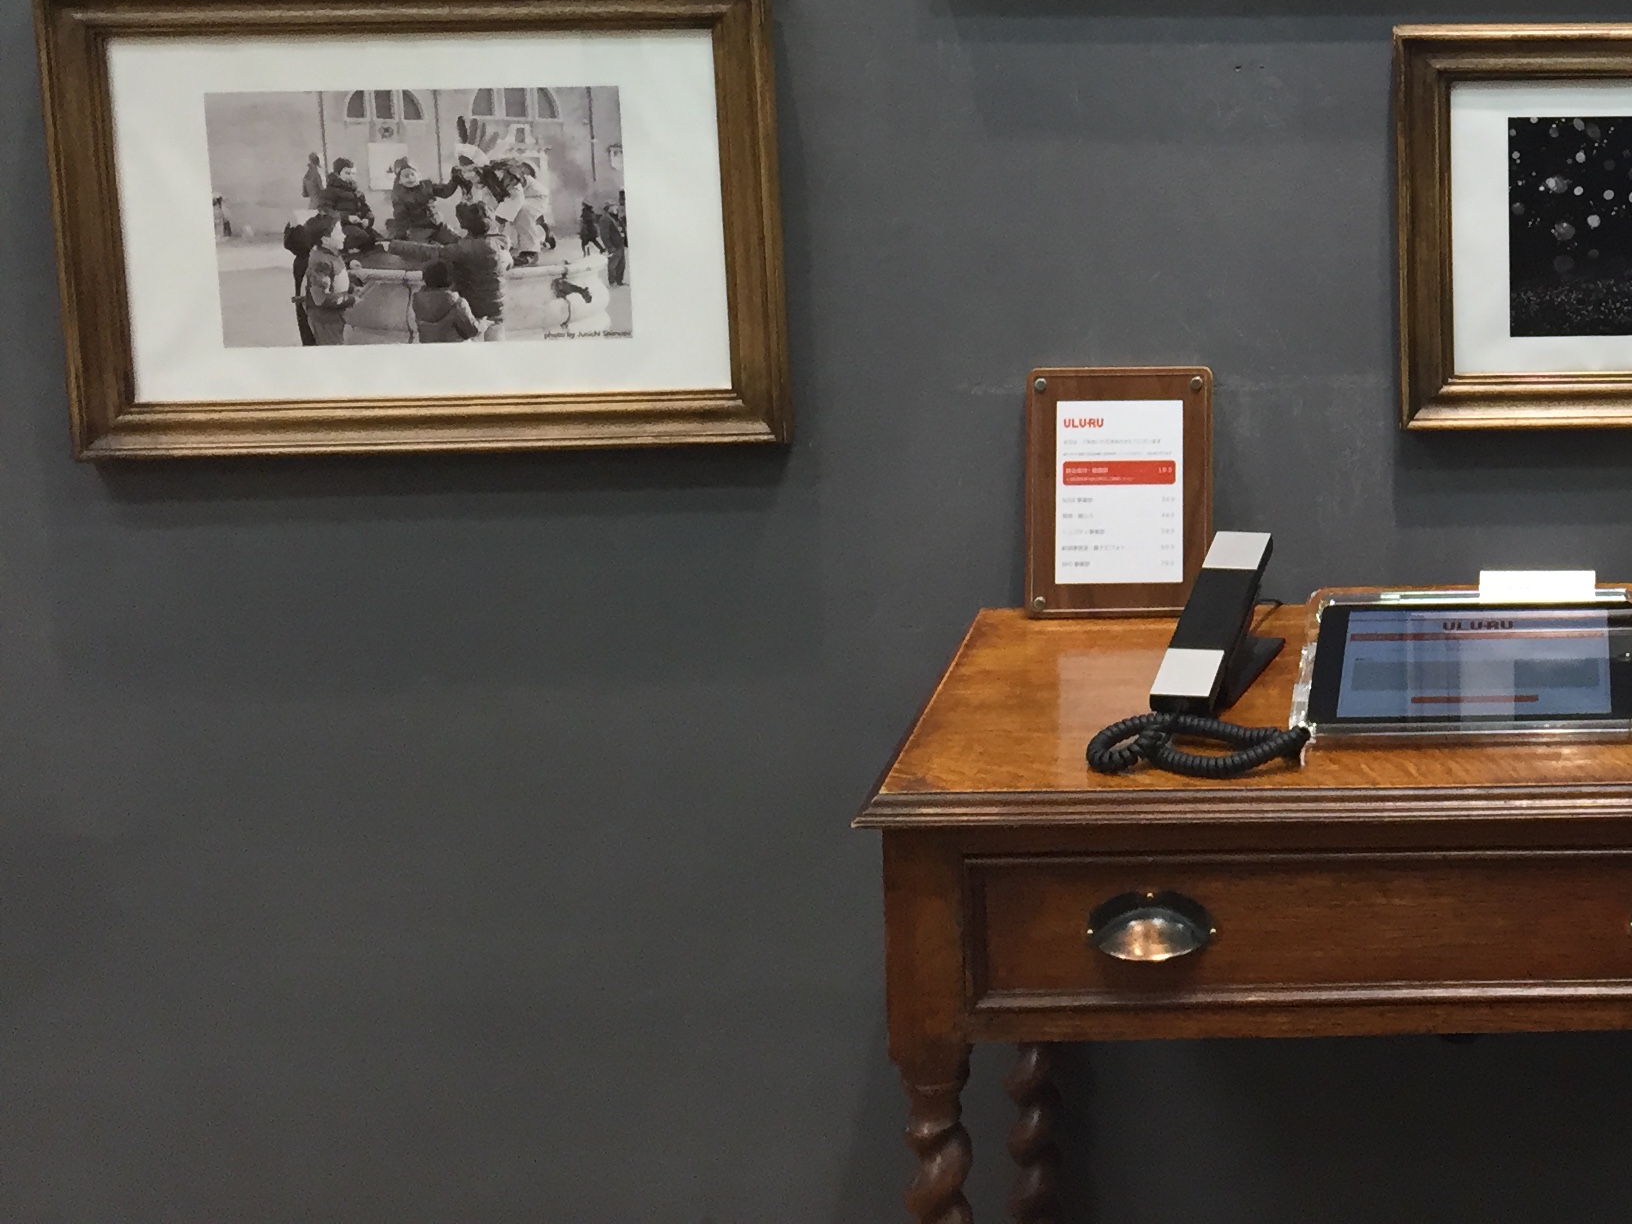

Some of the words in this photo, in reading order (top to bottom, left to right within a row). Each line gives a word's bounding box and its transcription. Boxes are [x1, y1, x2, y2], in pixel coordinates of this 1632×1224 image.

[544, 330, 565, 339] photo
[567, 331, 575, 339] by
[1063, 418, 1104, 428] ULURU
[1442, 620, 1514, 631] ULURU
